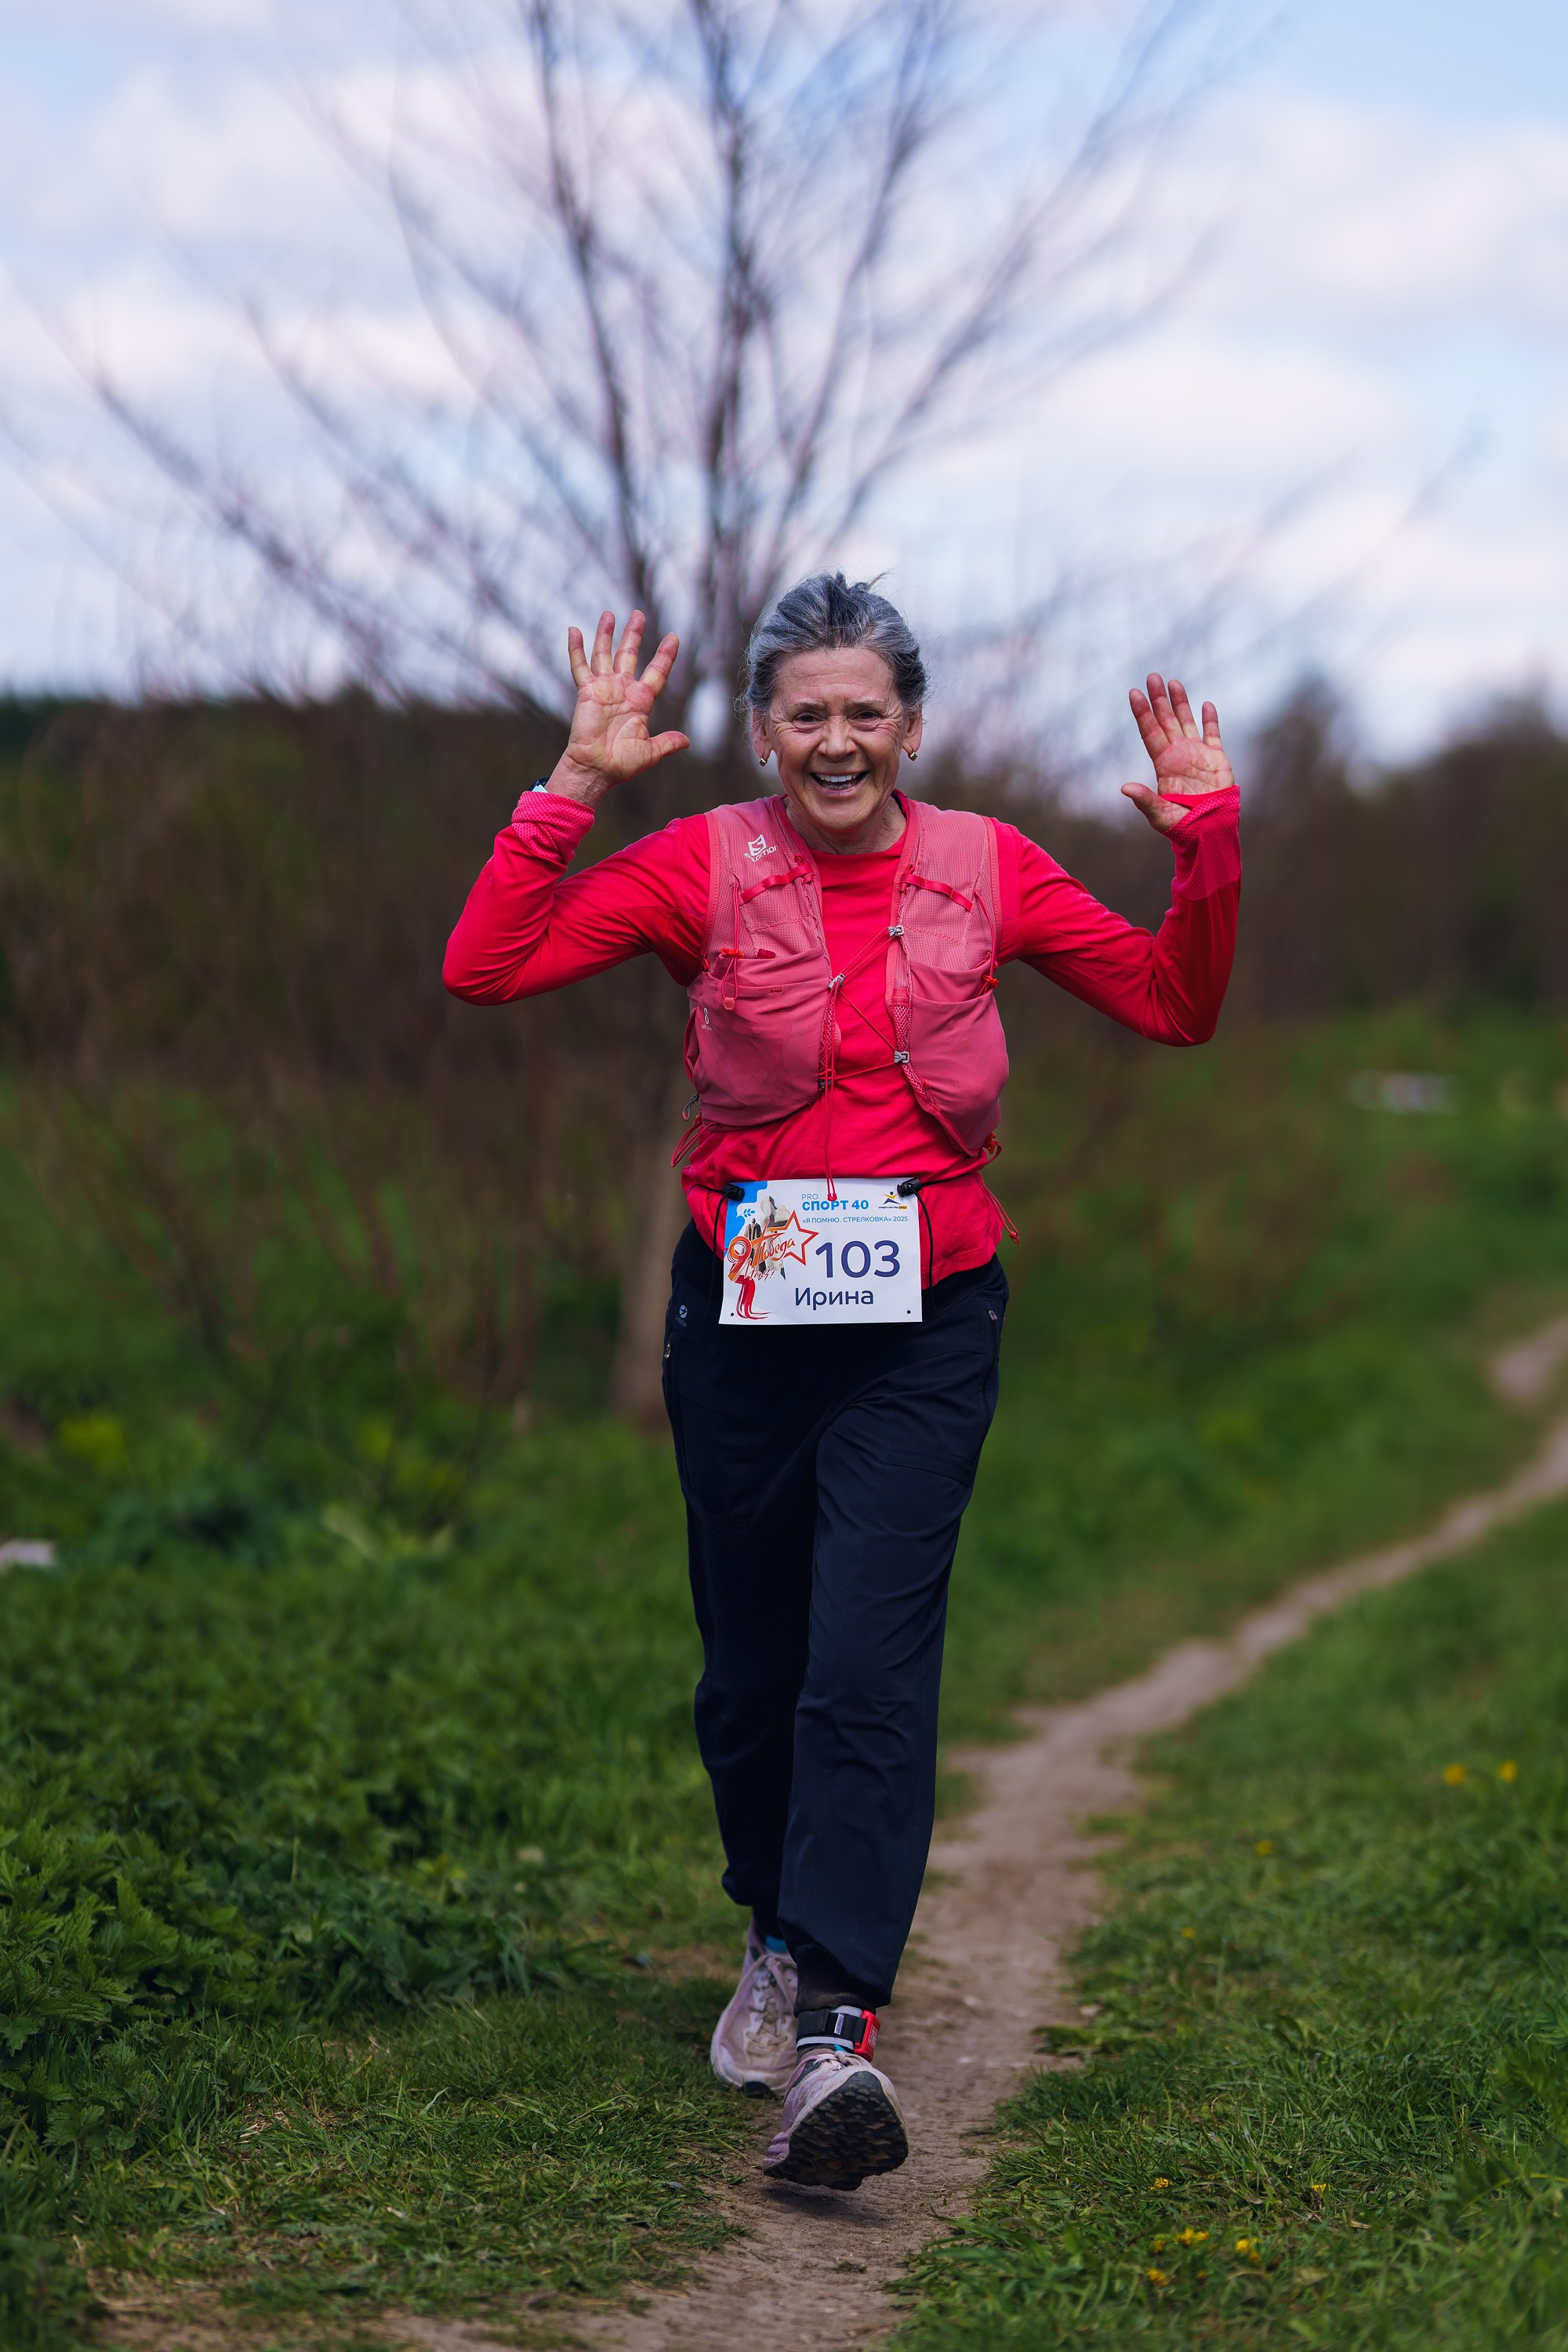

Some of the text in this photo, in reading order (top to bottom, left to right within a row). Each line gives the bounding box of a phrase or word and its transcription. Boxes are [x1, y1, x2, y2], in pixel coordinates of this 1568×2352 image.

[703, 1007, 710, 1025] 8
[802, 1200, 869, 1210] СПОРТ 40
[815, 1240, 901, 1279] 103
[795, 1287, 874, 1311] Ирина
